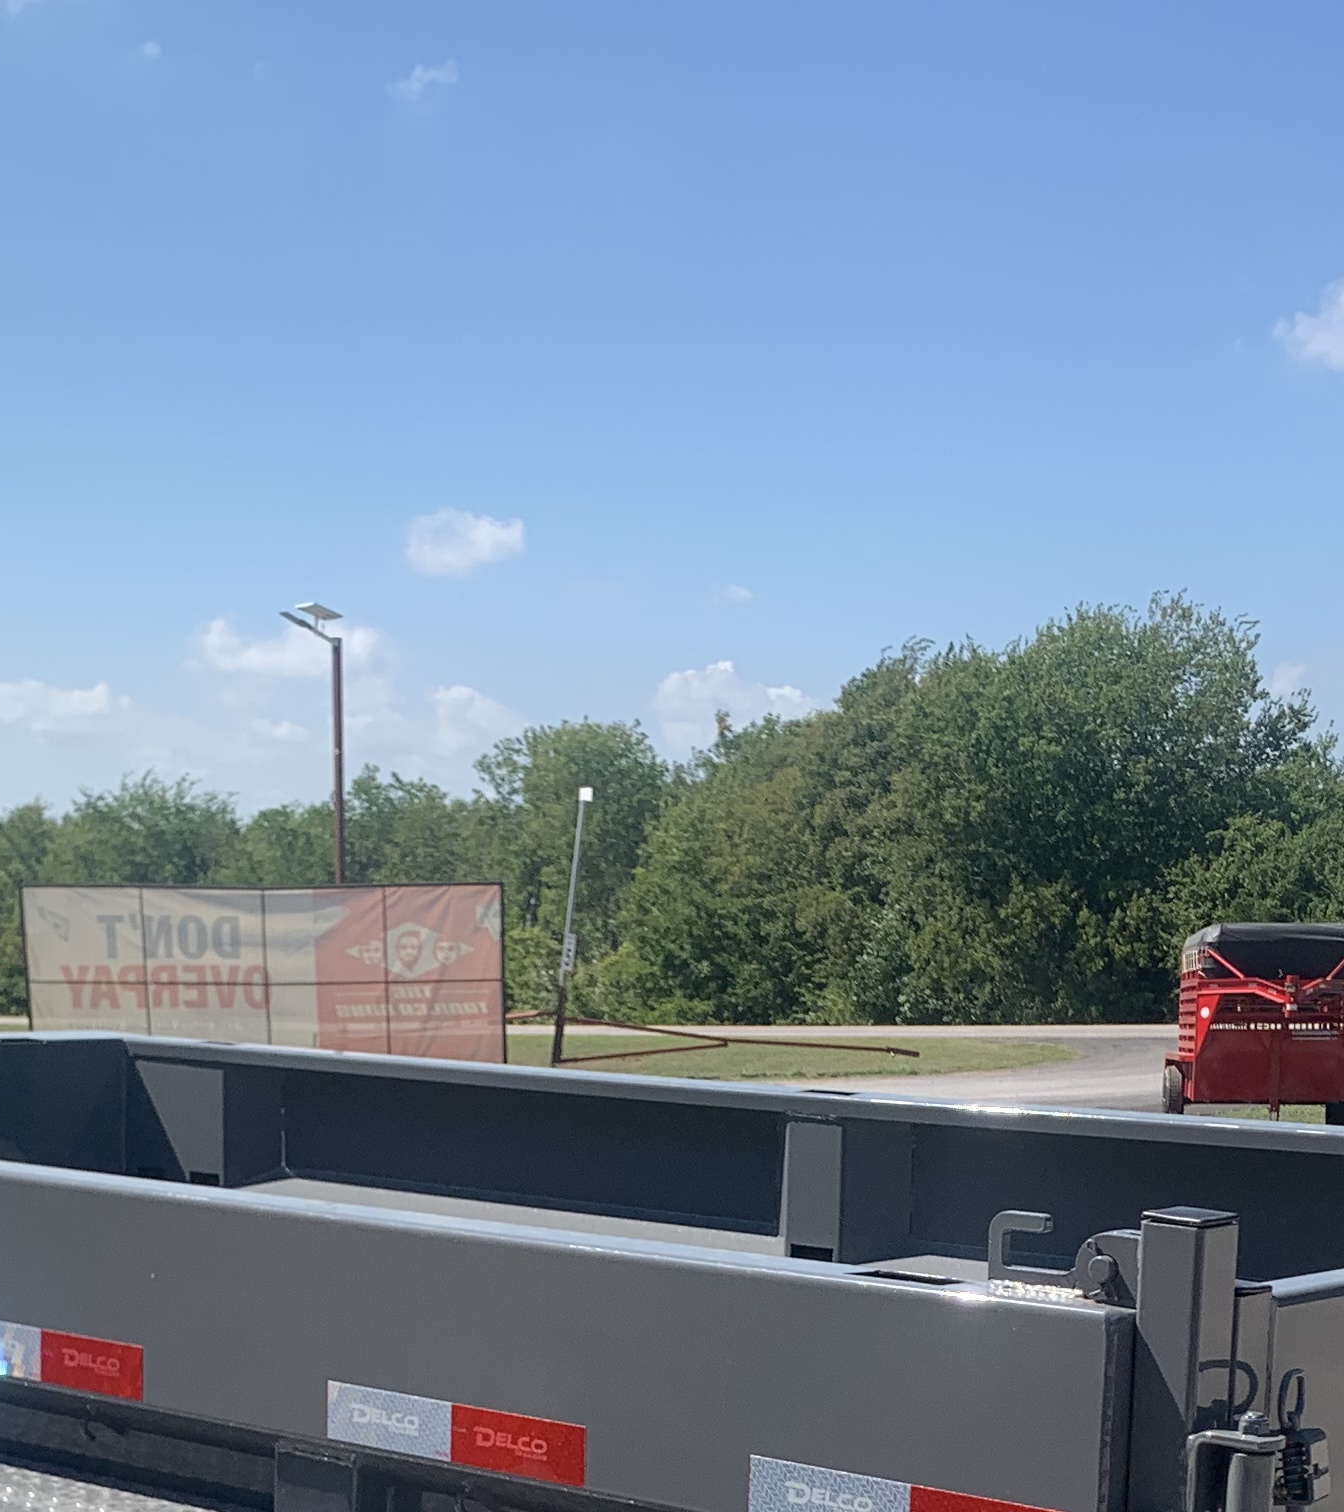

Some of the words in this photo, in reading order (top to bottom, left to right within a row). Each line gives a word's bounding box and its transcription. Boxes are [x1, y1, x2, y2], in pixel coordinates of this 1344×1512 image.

[62, 1348, 120, 1370] DELCO
[350, 1403, 419, 1429] DELCO
[473, 1426, 547, 1454] DELCO
[785, 1481, 873, 1512] DELCO
